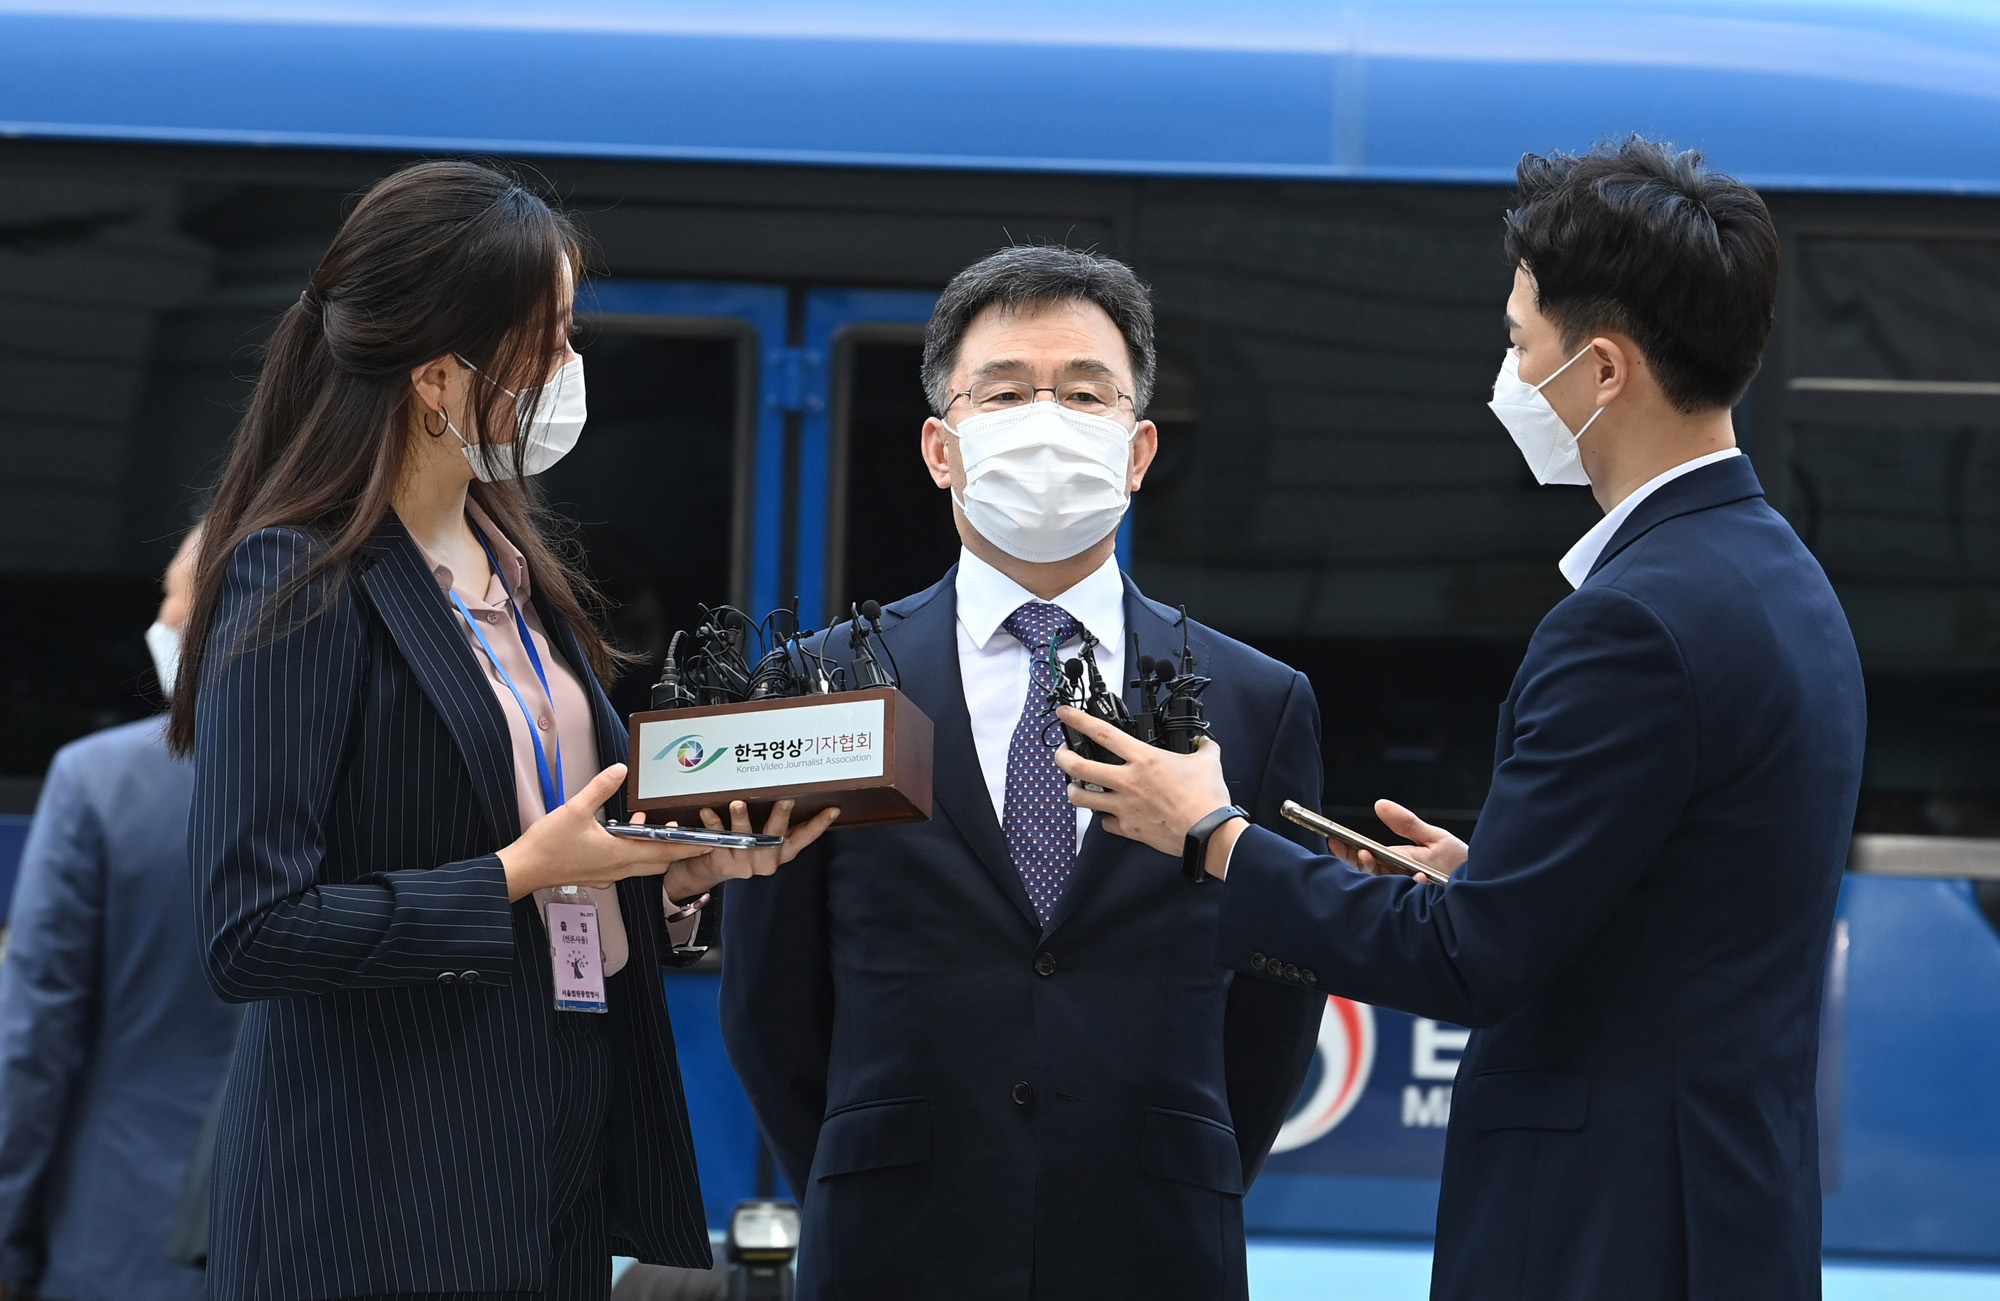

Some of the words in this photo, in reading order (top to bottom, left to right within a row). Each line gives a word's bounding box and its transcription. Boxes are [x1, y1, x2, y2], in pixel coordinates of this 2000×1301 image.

[734, 731, 872, 763] 한국영상기자협회
[736, 764, 760, 774] Korea
[760, 761, 784, 771] Video
[784, 758, 824, 769] Journalist
[825, 753, 872, 765] Association
